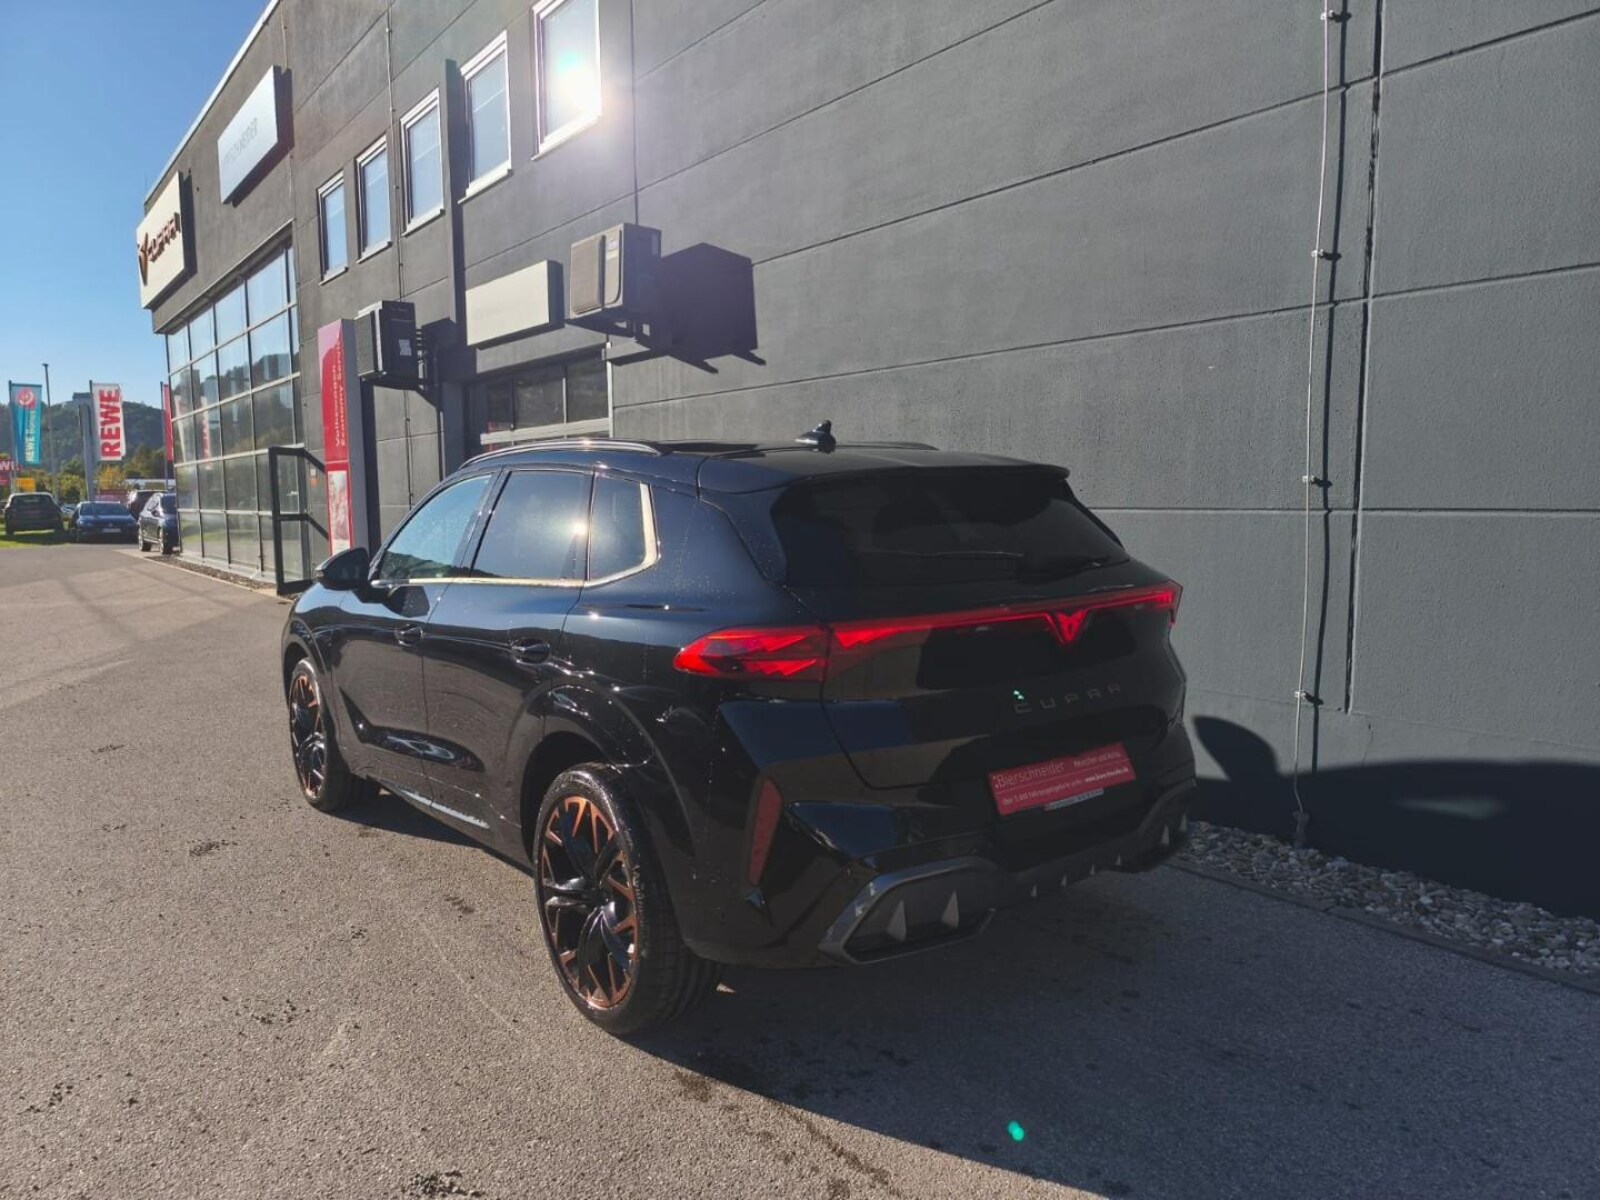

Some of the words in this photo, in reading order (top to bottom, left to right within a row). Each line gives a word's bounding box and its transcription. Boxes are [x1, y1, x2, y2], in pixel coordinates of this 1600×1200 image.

[100, 389, 121, 458] REWE
[332, 365, 340, 447] Volkswagen
[338, 385, 346, 447] Economy
[1014, 684, 1120, 713] CUPRA
[997, 760, 1064, 788] Bierschneider
